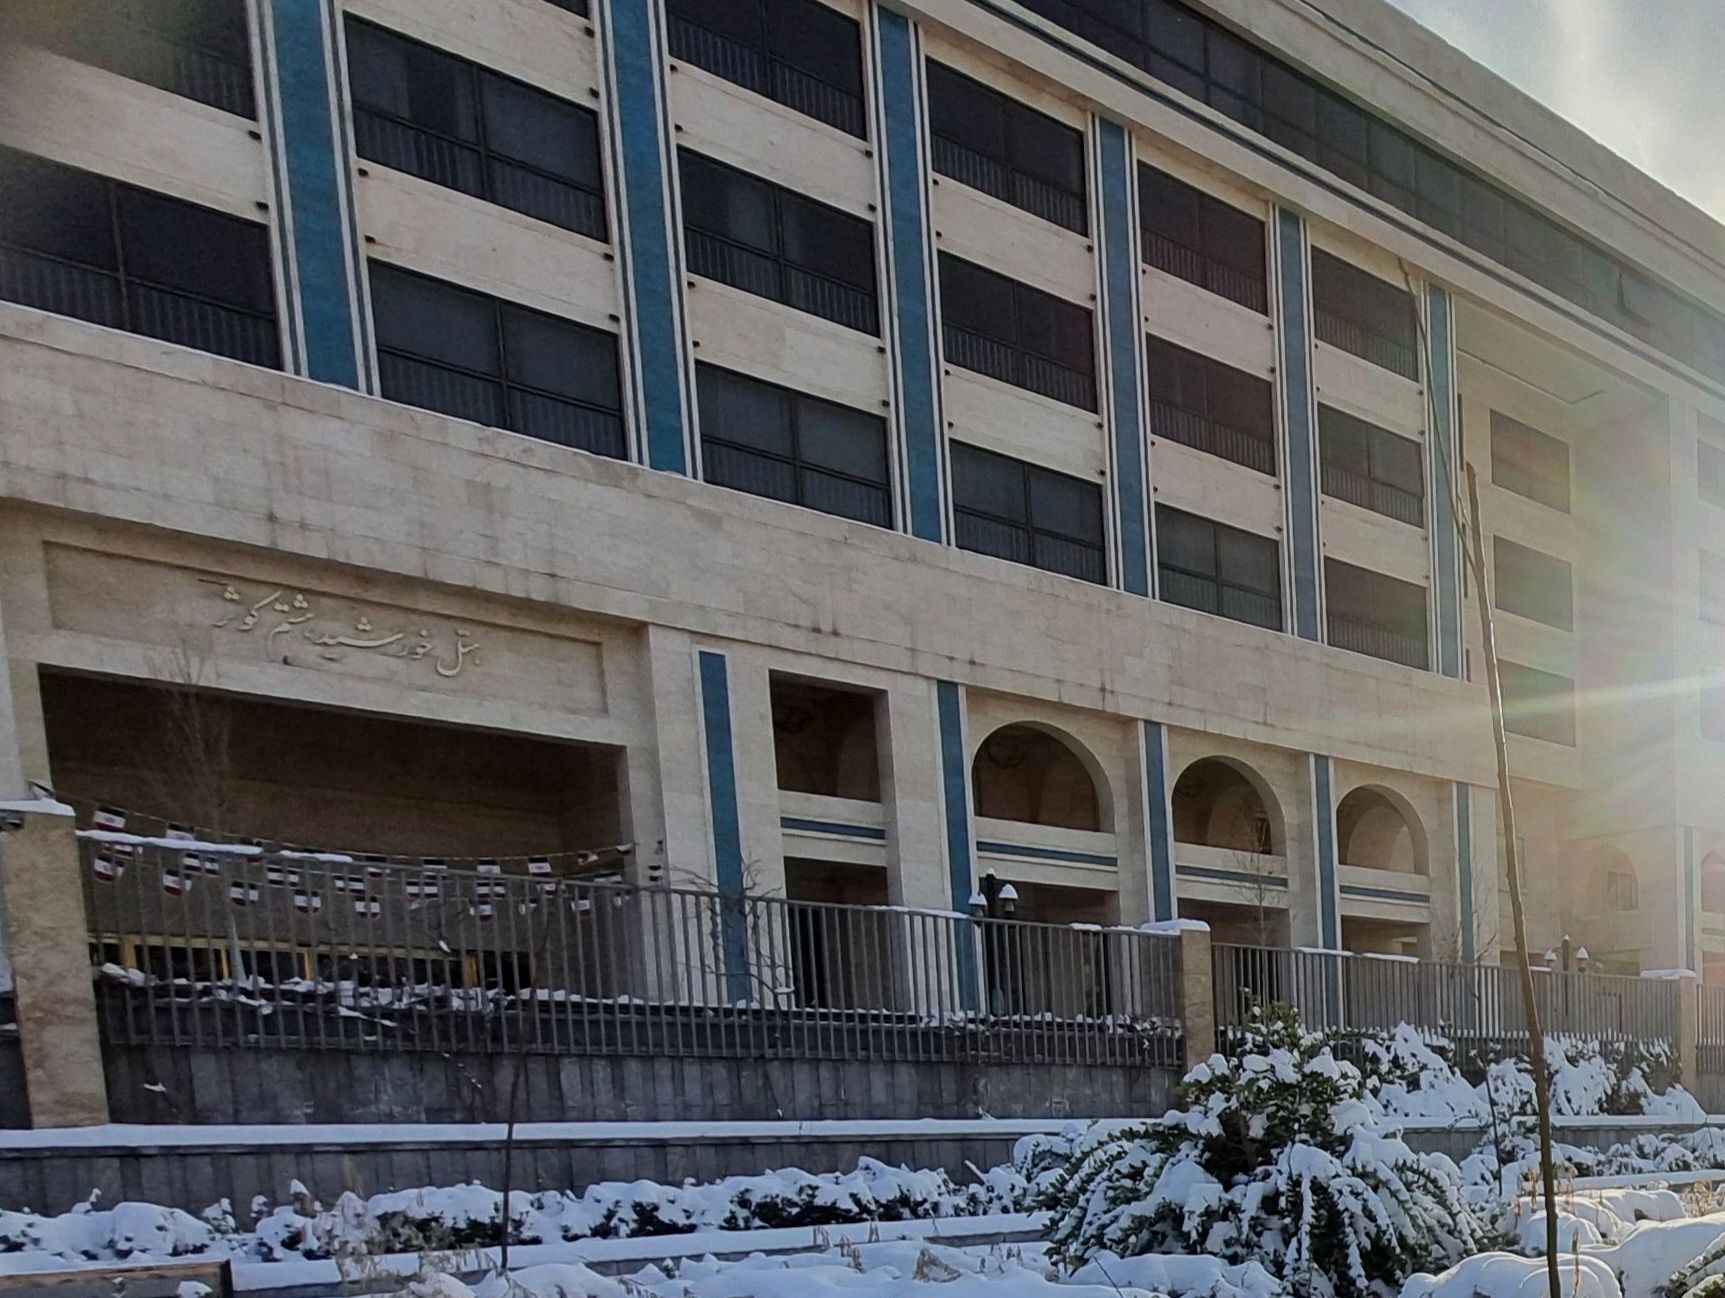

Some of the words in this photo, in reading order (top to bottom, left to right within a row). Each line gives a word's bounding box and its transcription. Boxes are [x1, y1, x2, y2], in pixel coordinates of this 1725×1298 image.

[212, 585, 282, 632] کوثر
[303, 616, 434, 661] خورشید
[437, 629, 481, 676] هتل
